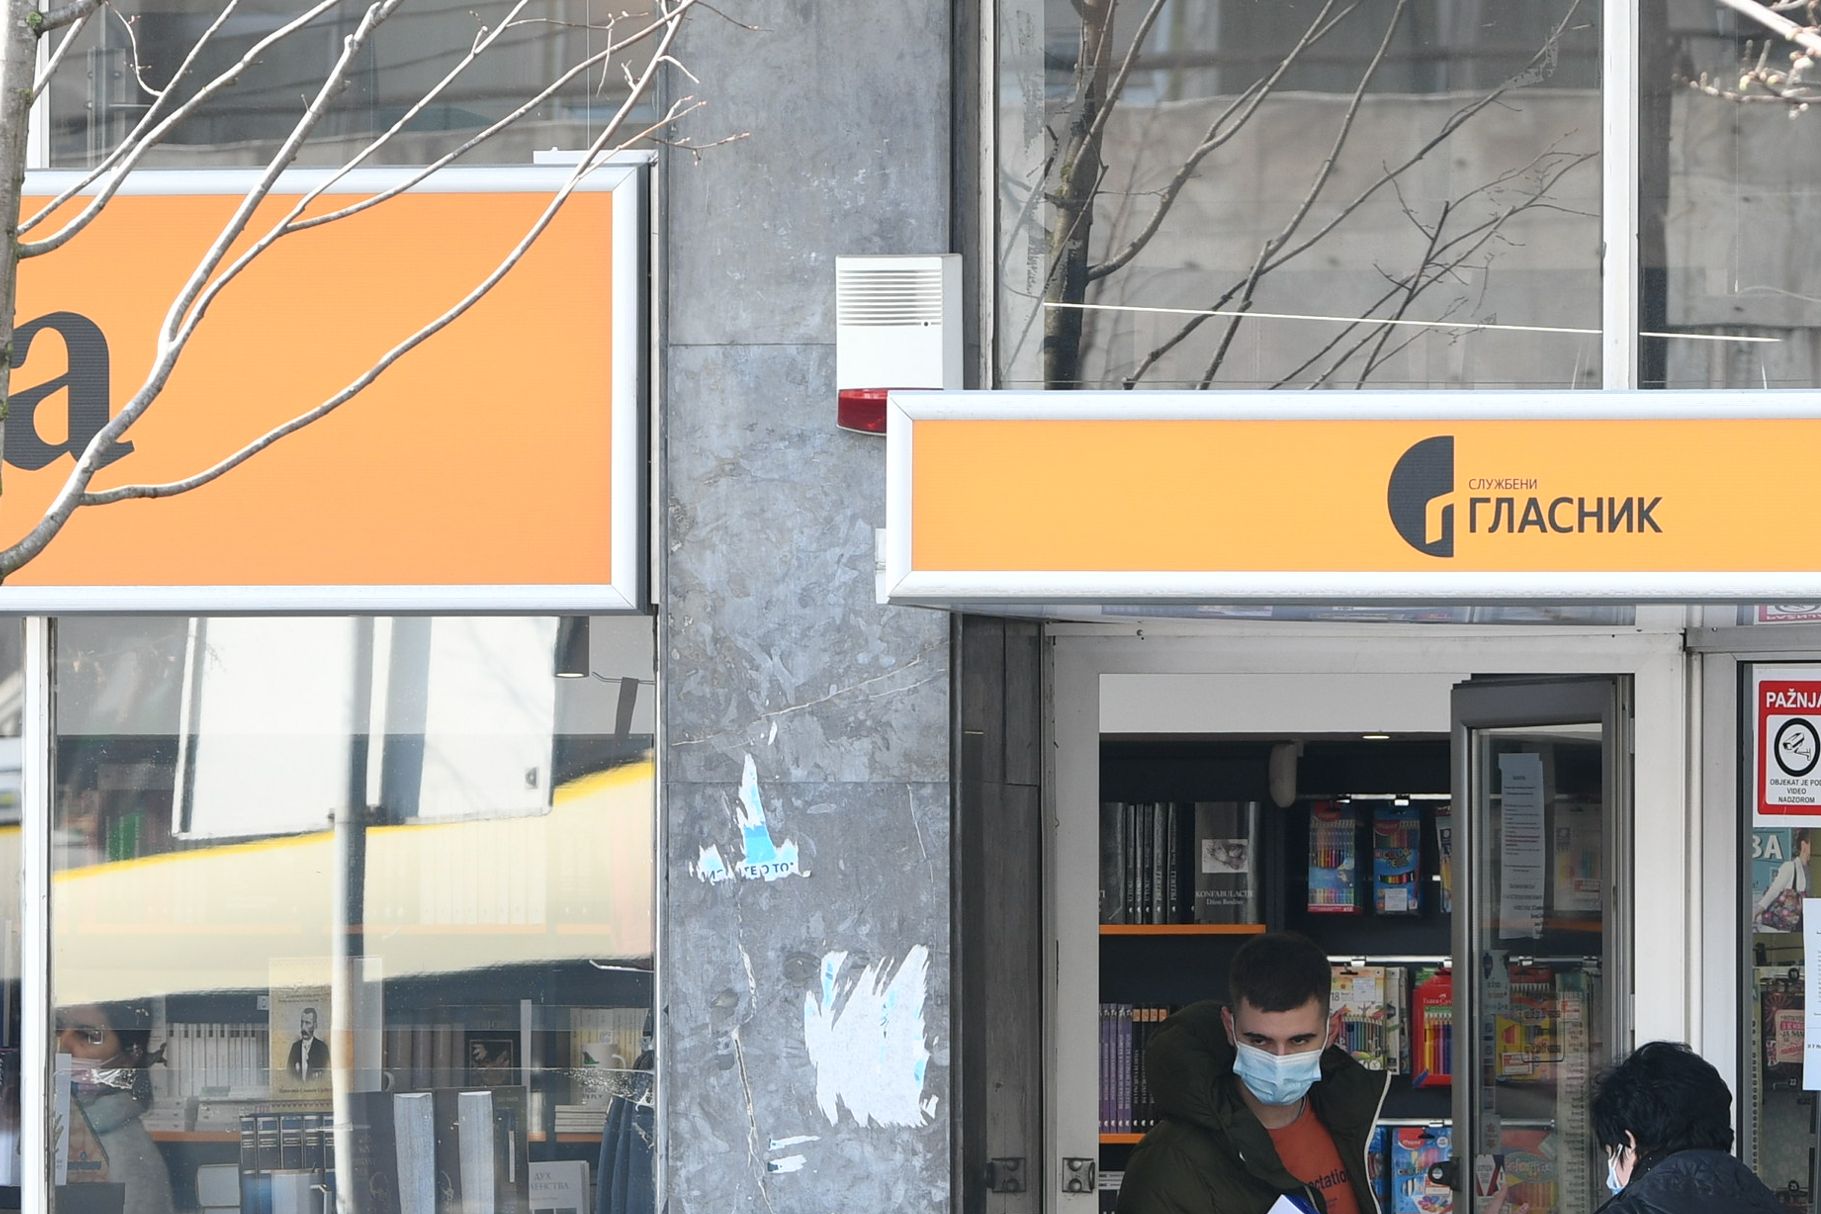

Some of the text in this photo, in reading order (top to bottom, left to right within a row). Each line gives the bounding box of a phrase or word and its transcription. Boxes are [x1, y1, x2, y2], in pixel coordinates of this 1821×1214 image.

[1468, 478, 1538, 490] СЛУЖБЕНИ
[1468, 496, 1663, 534] ГЛАСНИК
[1769, 779, 1799, 787] OBJEKAT
[1800, 779, 1808, 787] JE
[1786, 787, 1807, 795] VIDEO
[1778, 796, 1816, 804] NADZOROM
